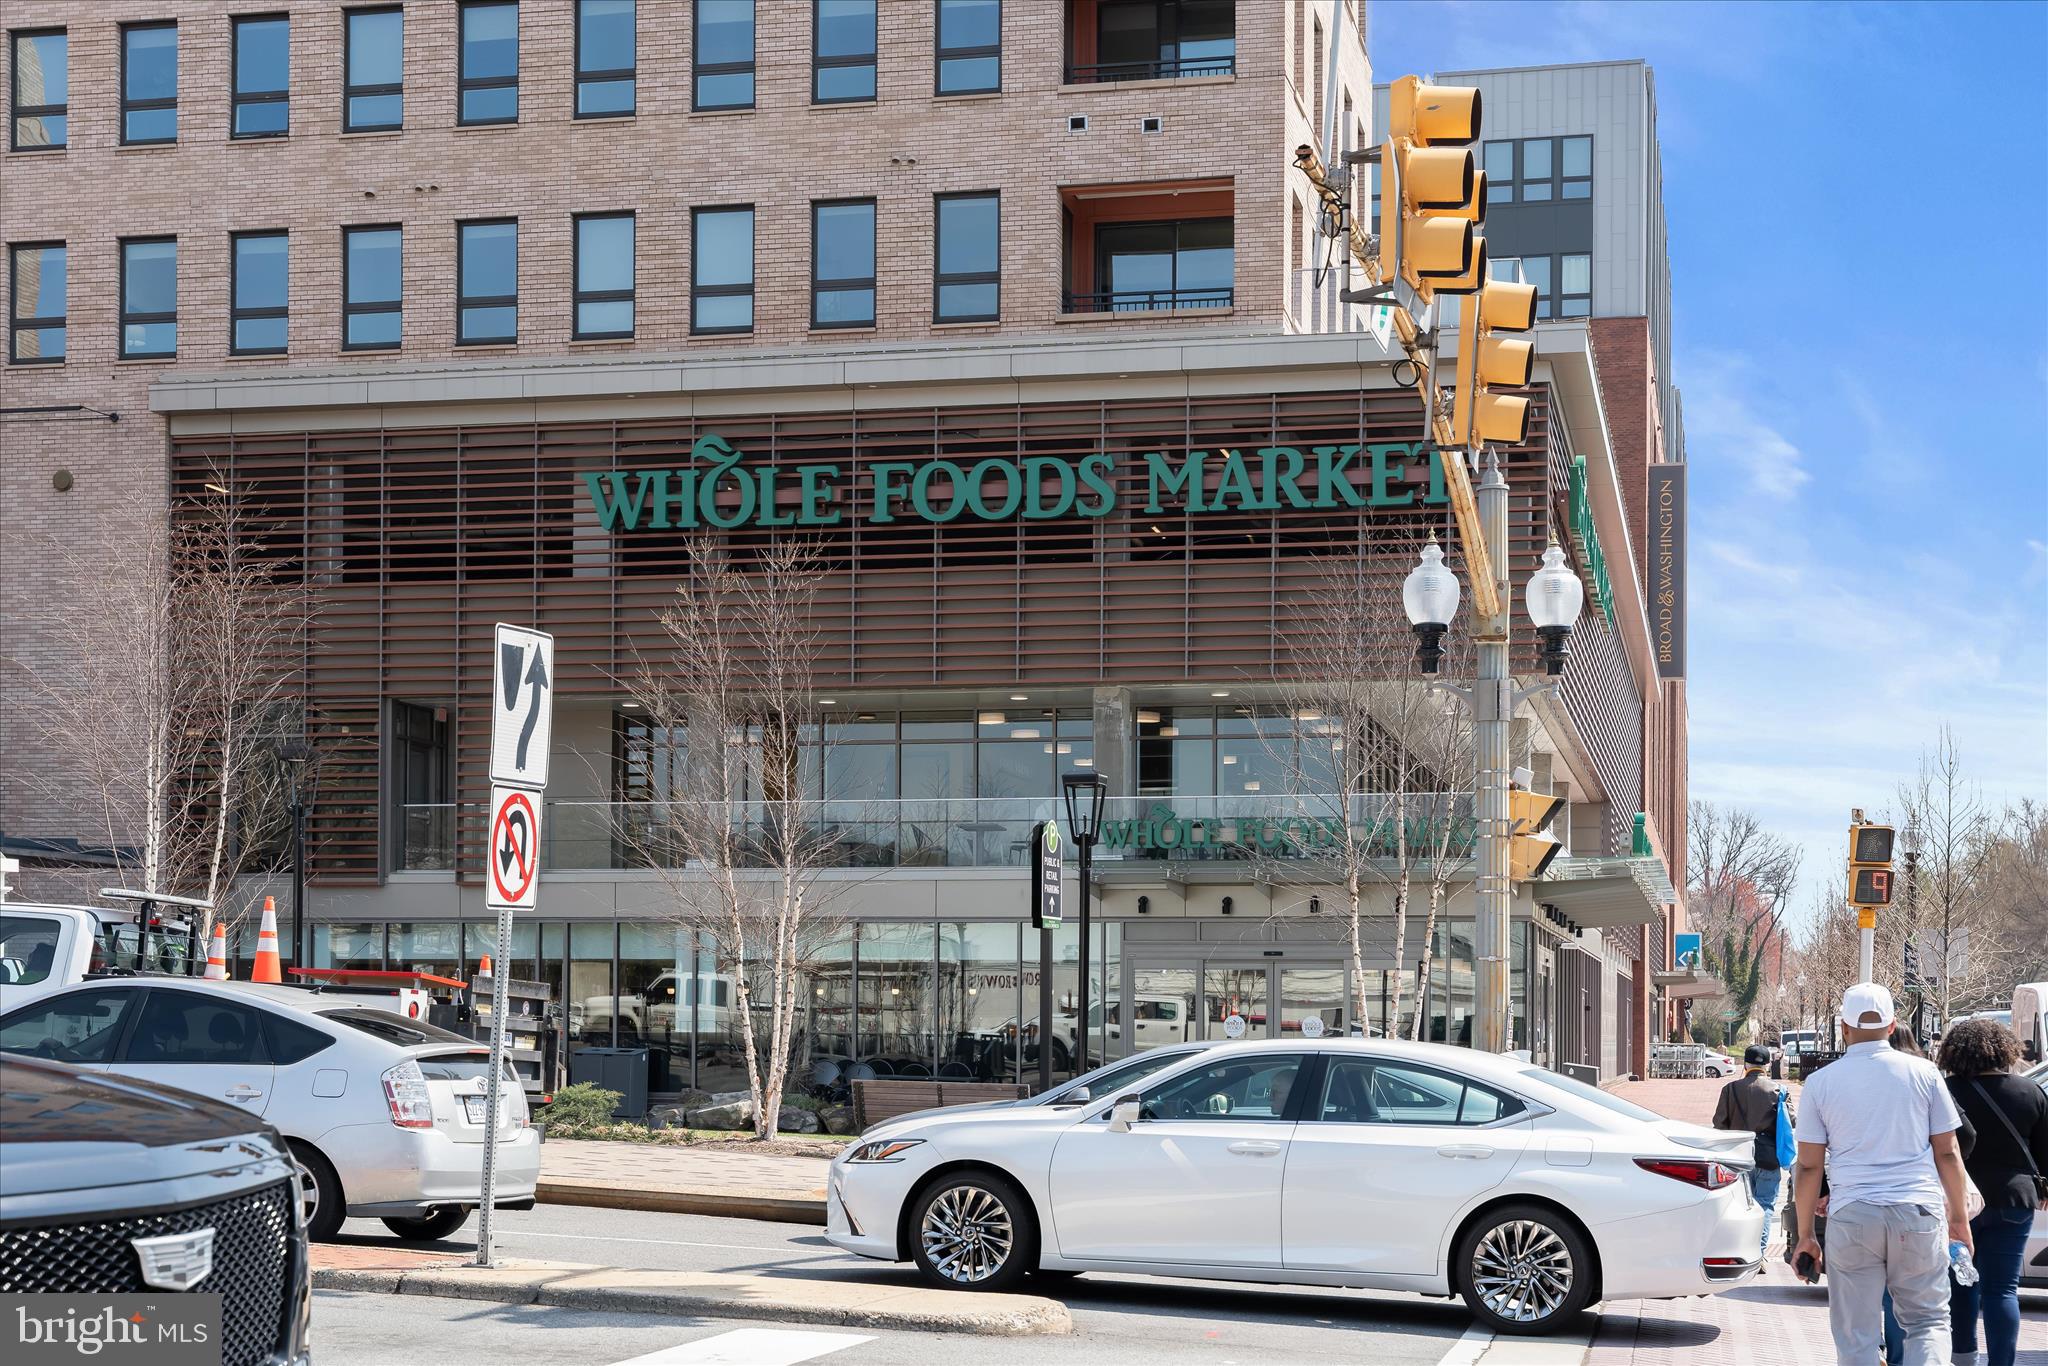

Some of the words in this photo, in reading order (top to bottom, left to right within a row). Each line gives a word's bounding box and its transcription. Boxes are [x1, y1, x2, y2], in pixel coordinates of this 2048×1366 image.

[581, 434, 842, 531] WHOLE
[868, 453, 1117, 523] FOODS
[1143, 443, 1452, 514] MARKET
[1659, 479, 1673, 590] WASHINGTON
[1659, 608, 1673, 663] BROAD
[1100, 803, 1224, 850] WHOLE
[1044, 856, 1057, 868] PUBLIC
[1045, 870, 1058, 881] RETAIL
[1044, 883, 1060, 895] PARKING
[1872, 872, 1888, 902] 9
